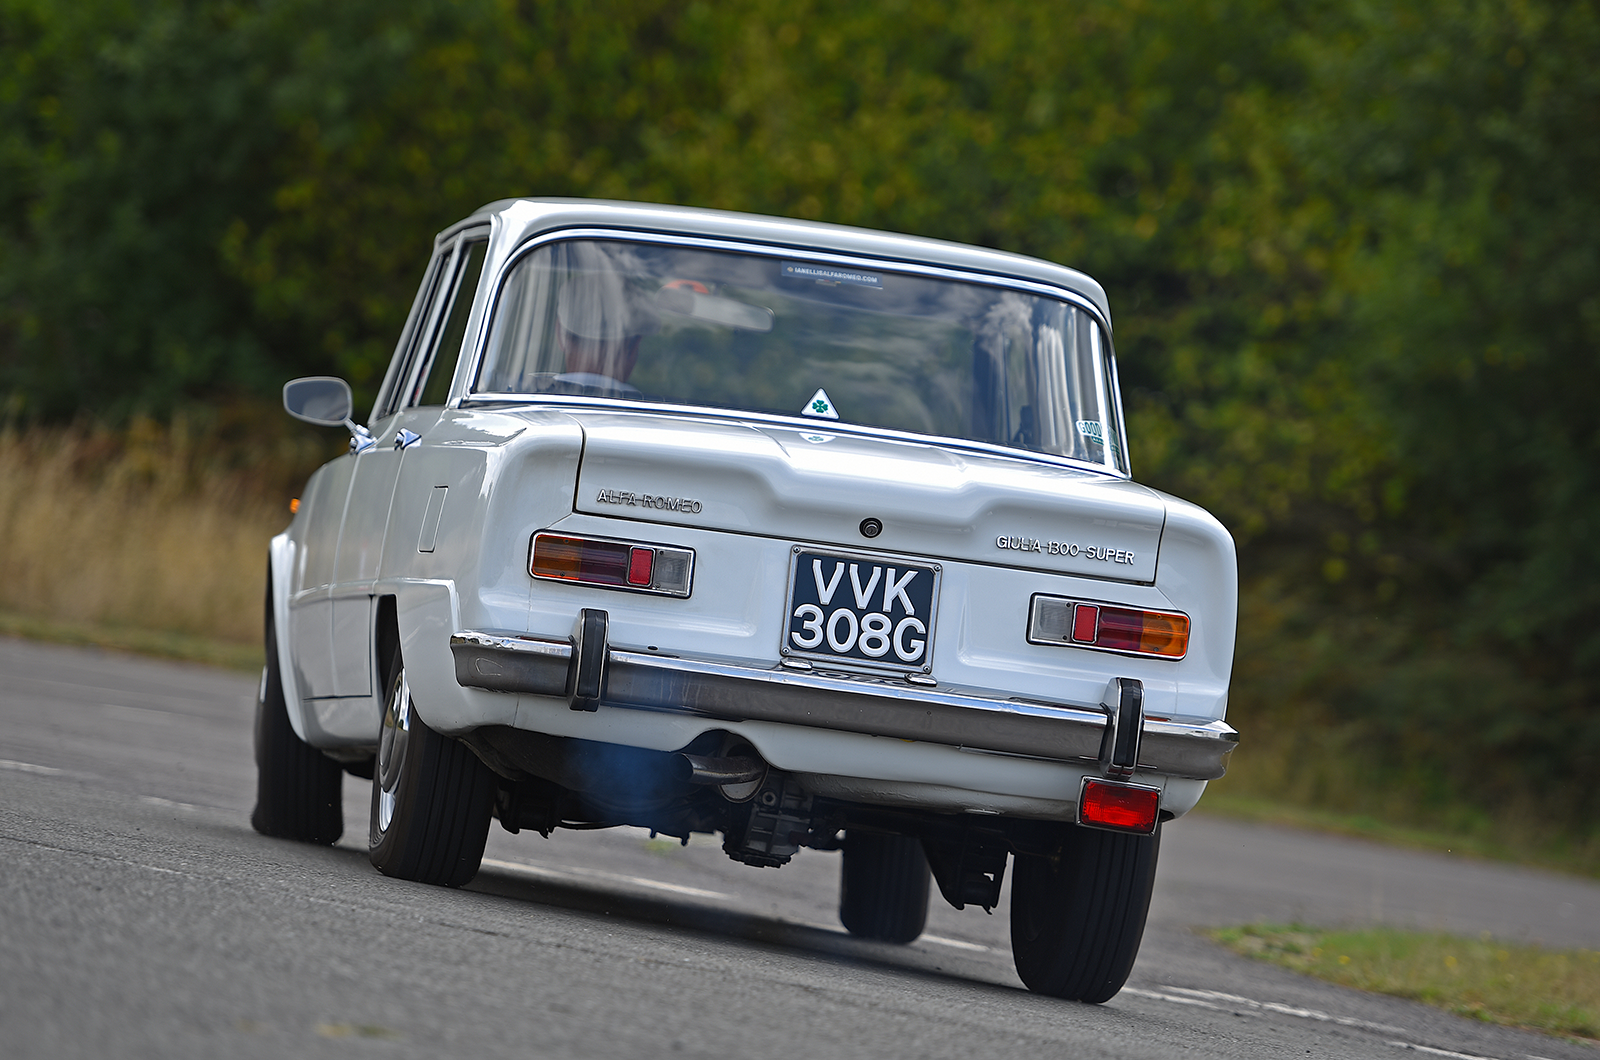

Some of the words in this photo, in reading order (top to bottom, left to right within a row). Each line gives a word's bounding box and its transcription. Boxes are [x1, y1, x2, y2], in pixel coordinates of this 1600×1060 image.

[597, 488, 637, 507] ALFA
[642, 494, 703, 514] ROMEO
[996, 535, 1042, 554] GIULIA
[1047, 540, 1080, 557] 1300
[1085, 545, 1135, 565] SUPER
[812, 558, 918, 616] VVK
[791, 603, 927, 663] 308G
